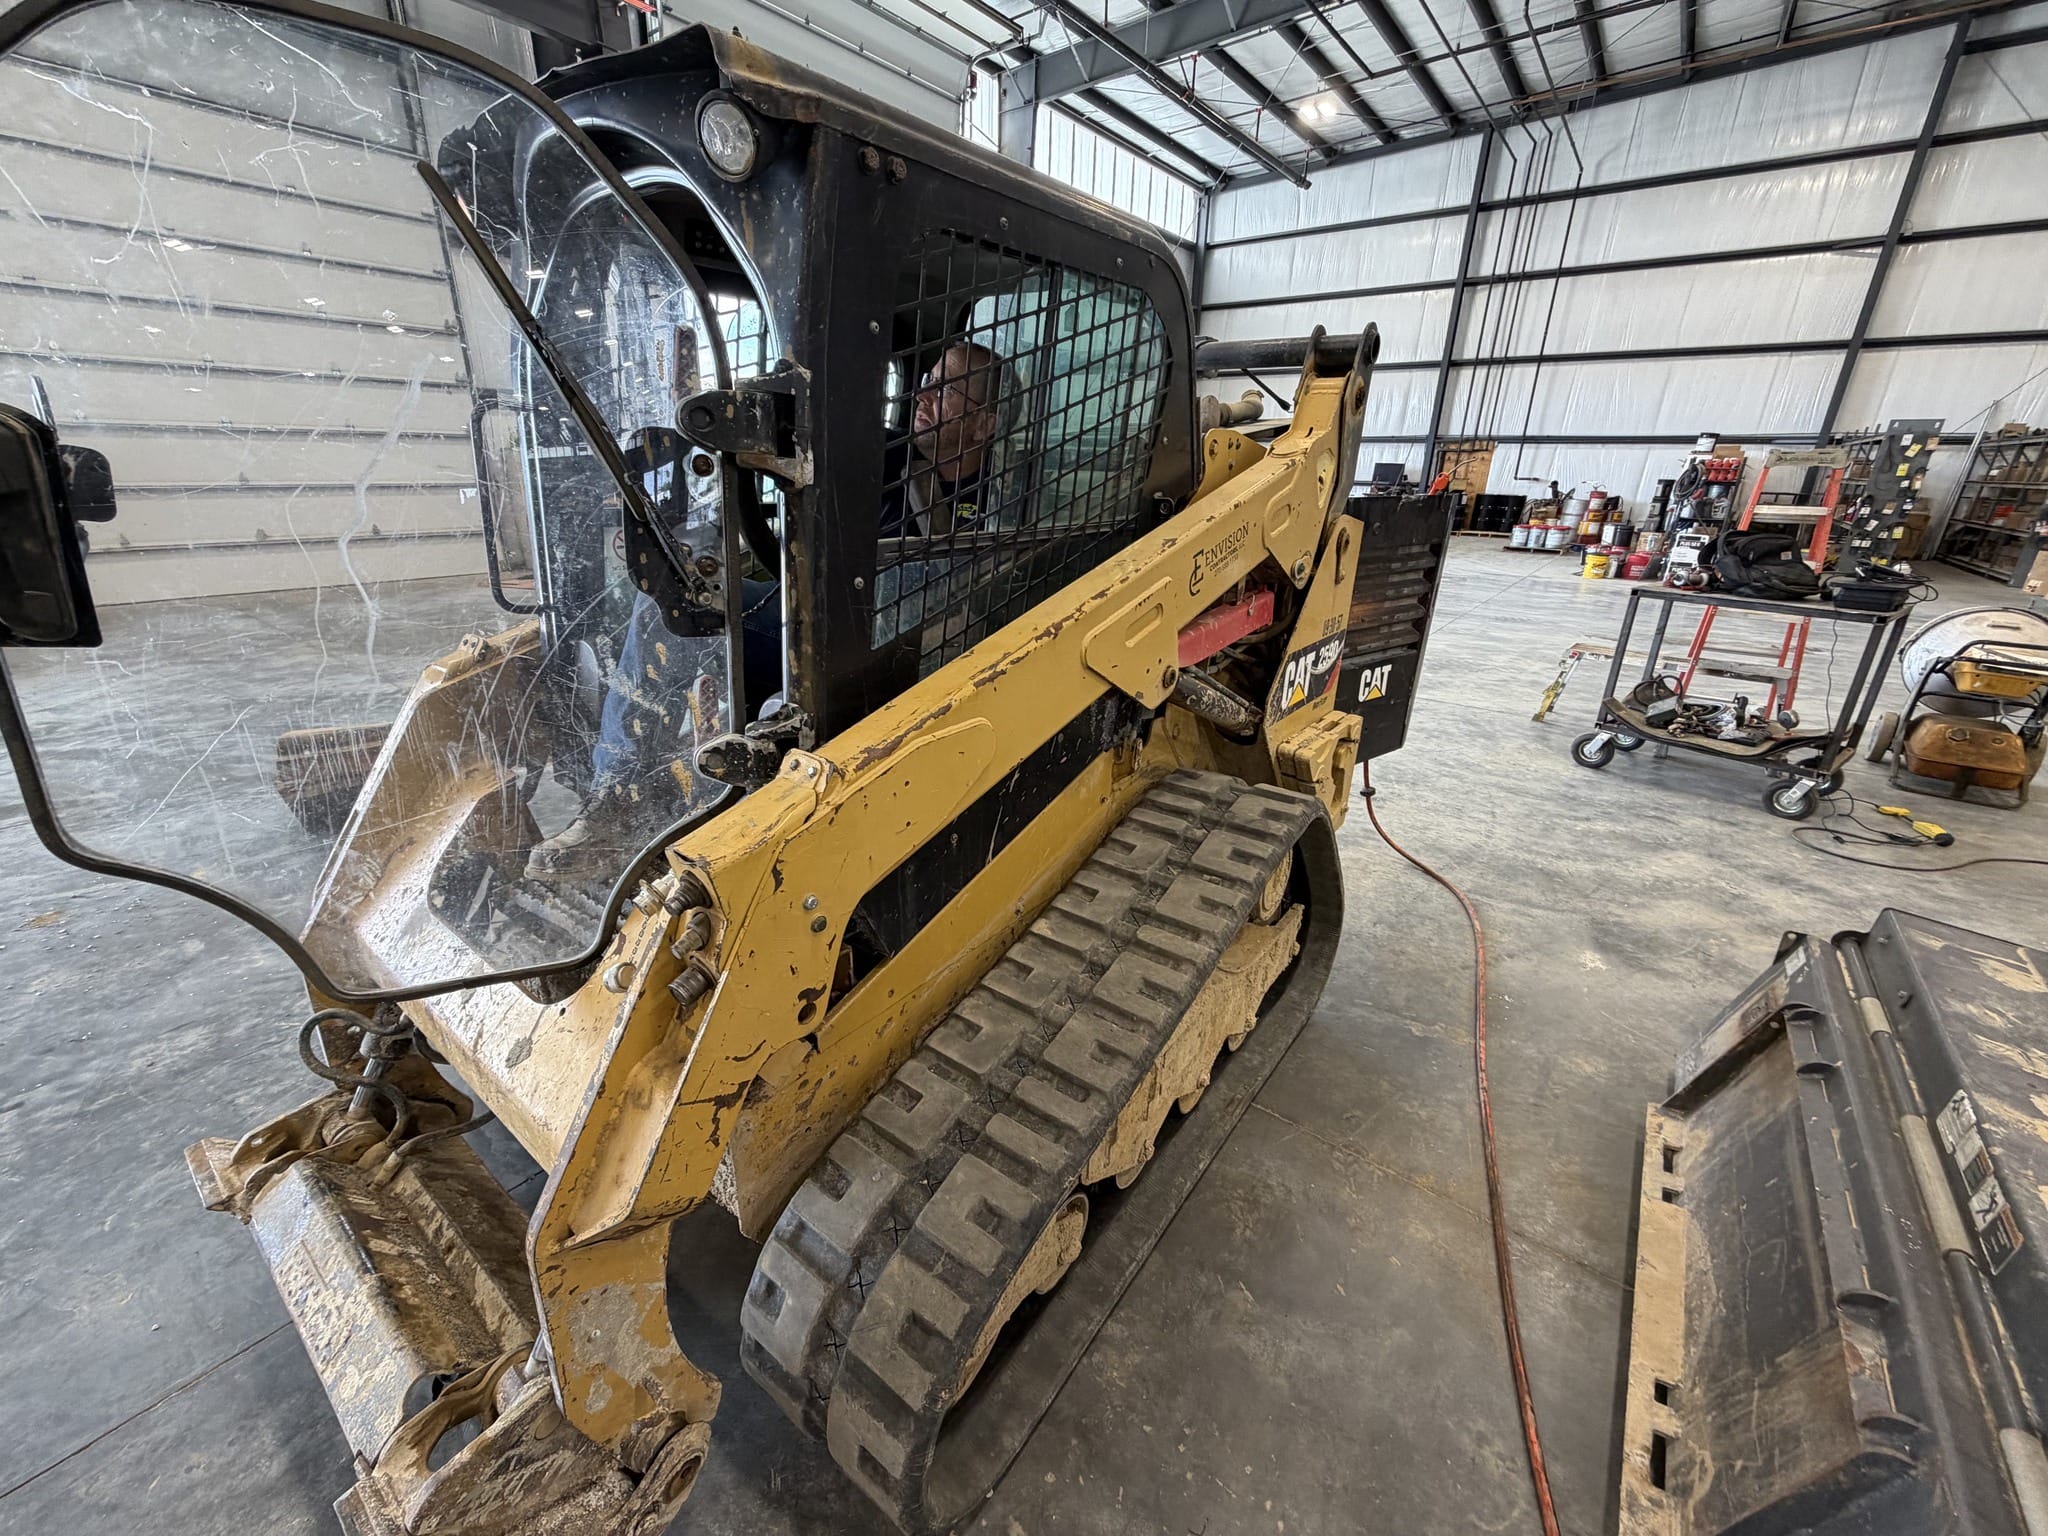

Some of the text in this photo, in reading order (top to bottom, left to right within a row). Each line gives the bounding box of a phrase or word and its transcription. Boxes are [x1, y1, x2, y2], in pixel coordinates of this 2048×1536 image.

[1205, 521, 1249, 567] ENVISION
[1281, 640, 1340, 710] CAT 259D
[1358, 664, 1393, 702] CAT
